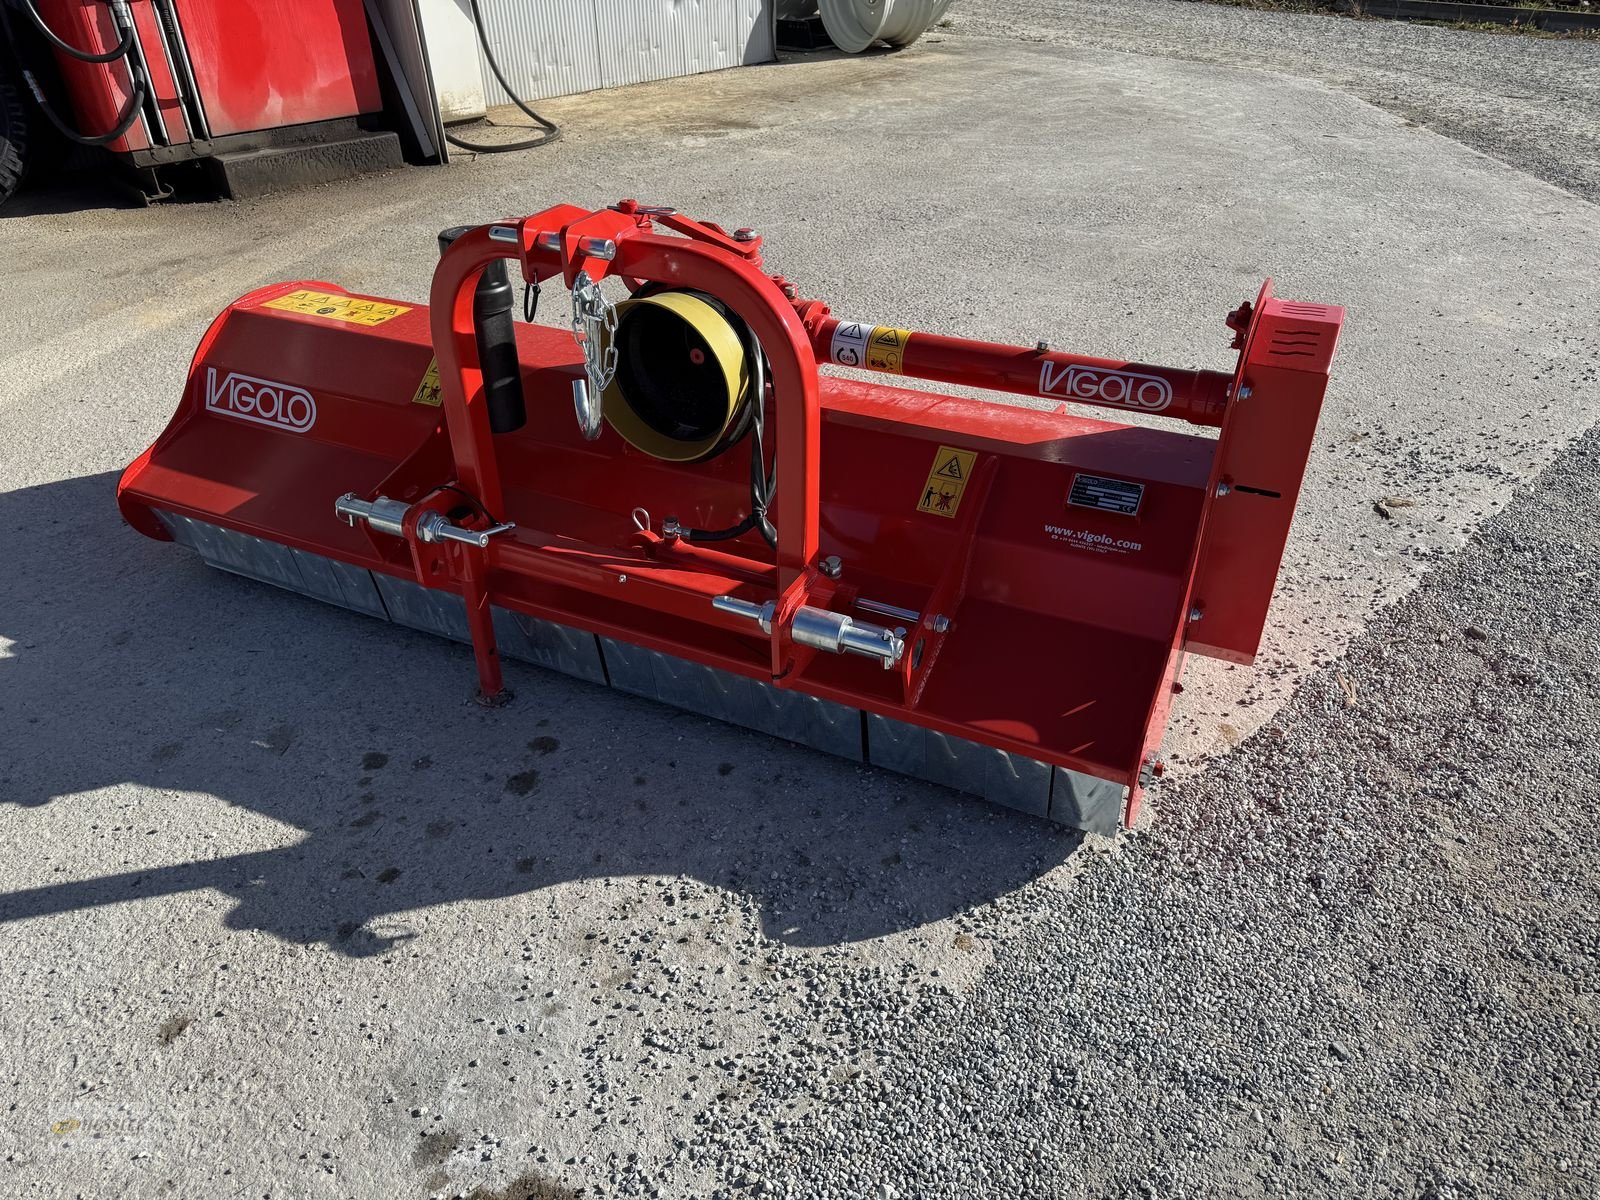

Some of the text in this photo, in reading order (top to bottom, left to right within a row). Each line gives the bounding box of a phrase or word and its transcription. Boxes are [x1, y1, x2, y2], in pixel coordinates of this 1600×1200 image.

[206, 367, 317, 433] VIGOLO
[1039, 360, 1173, 412] VIGOLO
[1044, 524, 1142, 551] www.vigolo.com
